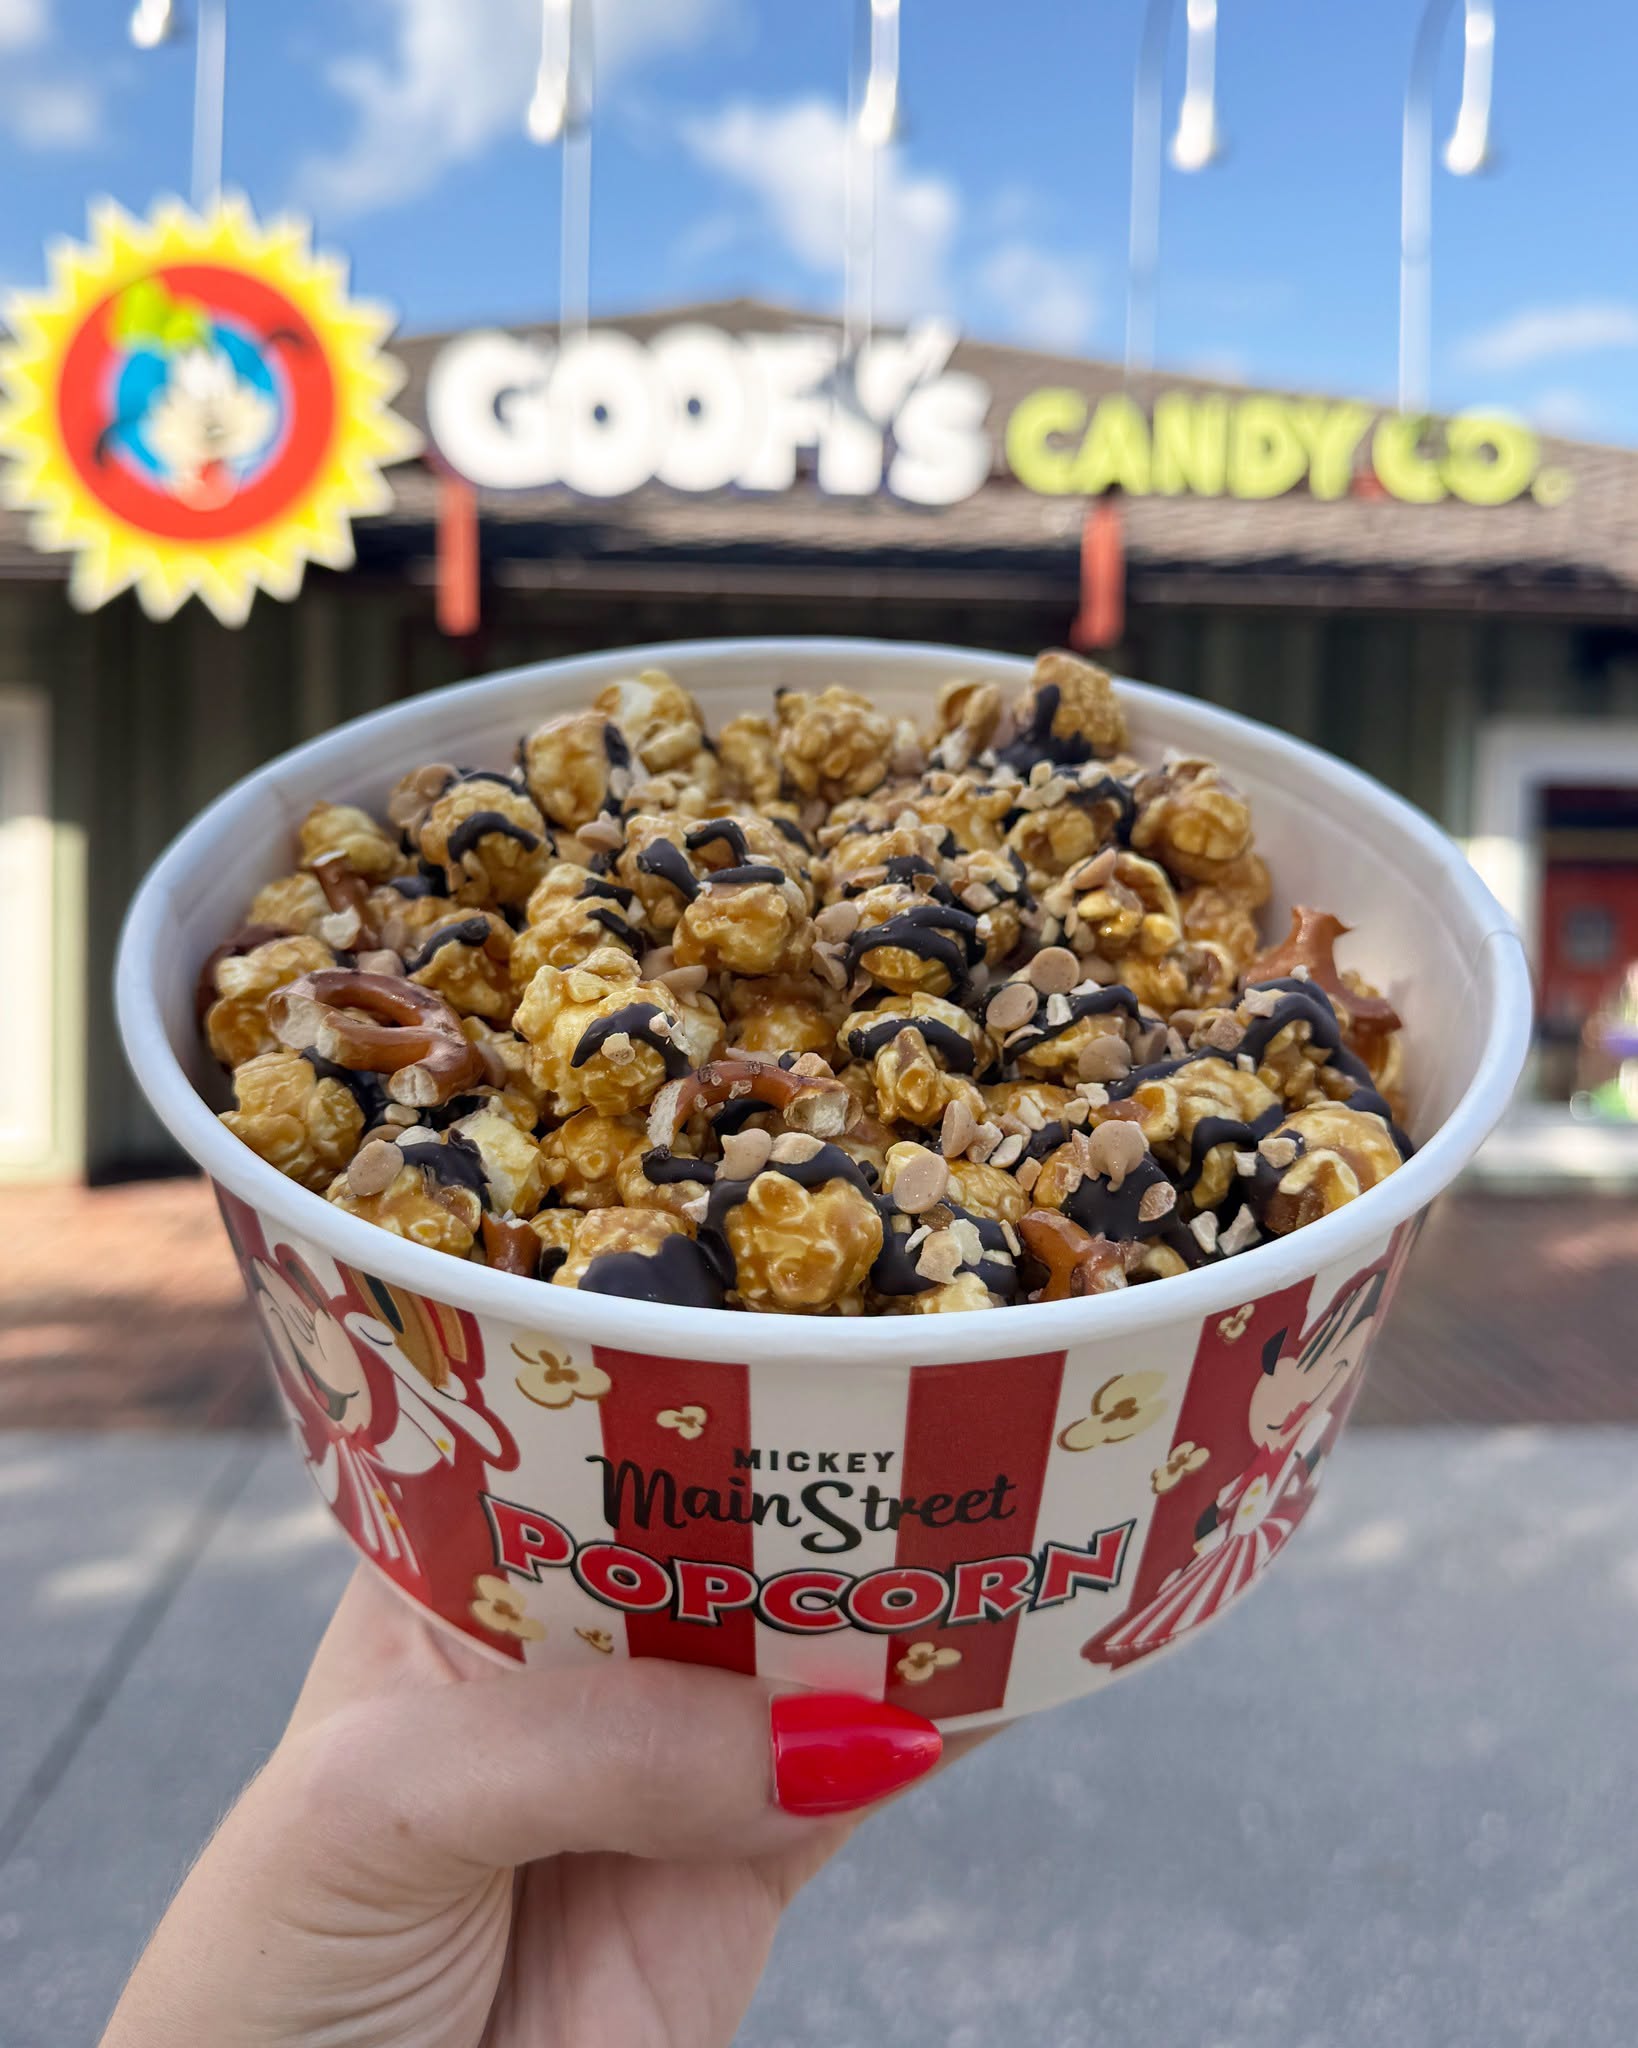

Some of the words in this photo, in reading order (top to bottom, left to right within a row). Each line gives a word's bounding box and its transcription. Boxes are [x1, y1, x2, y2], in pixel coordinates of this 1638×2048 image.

[1005, 387, 1374, 500] CANDY
[1372, 406, 1574, 508] CO.
[733, 1448, 896, 1475] MICKEY
[480, 1491, 1138, 1636] POPCORN
